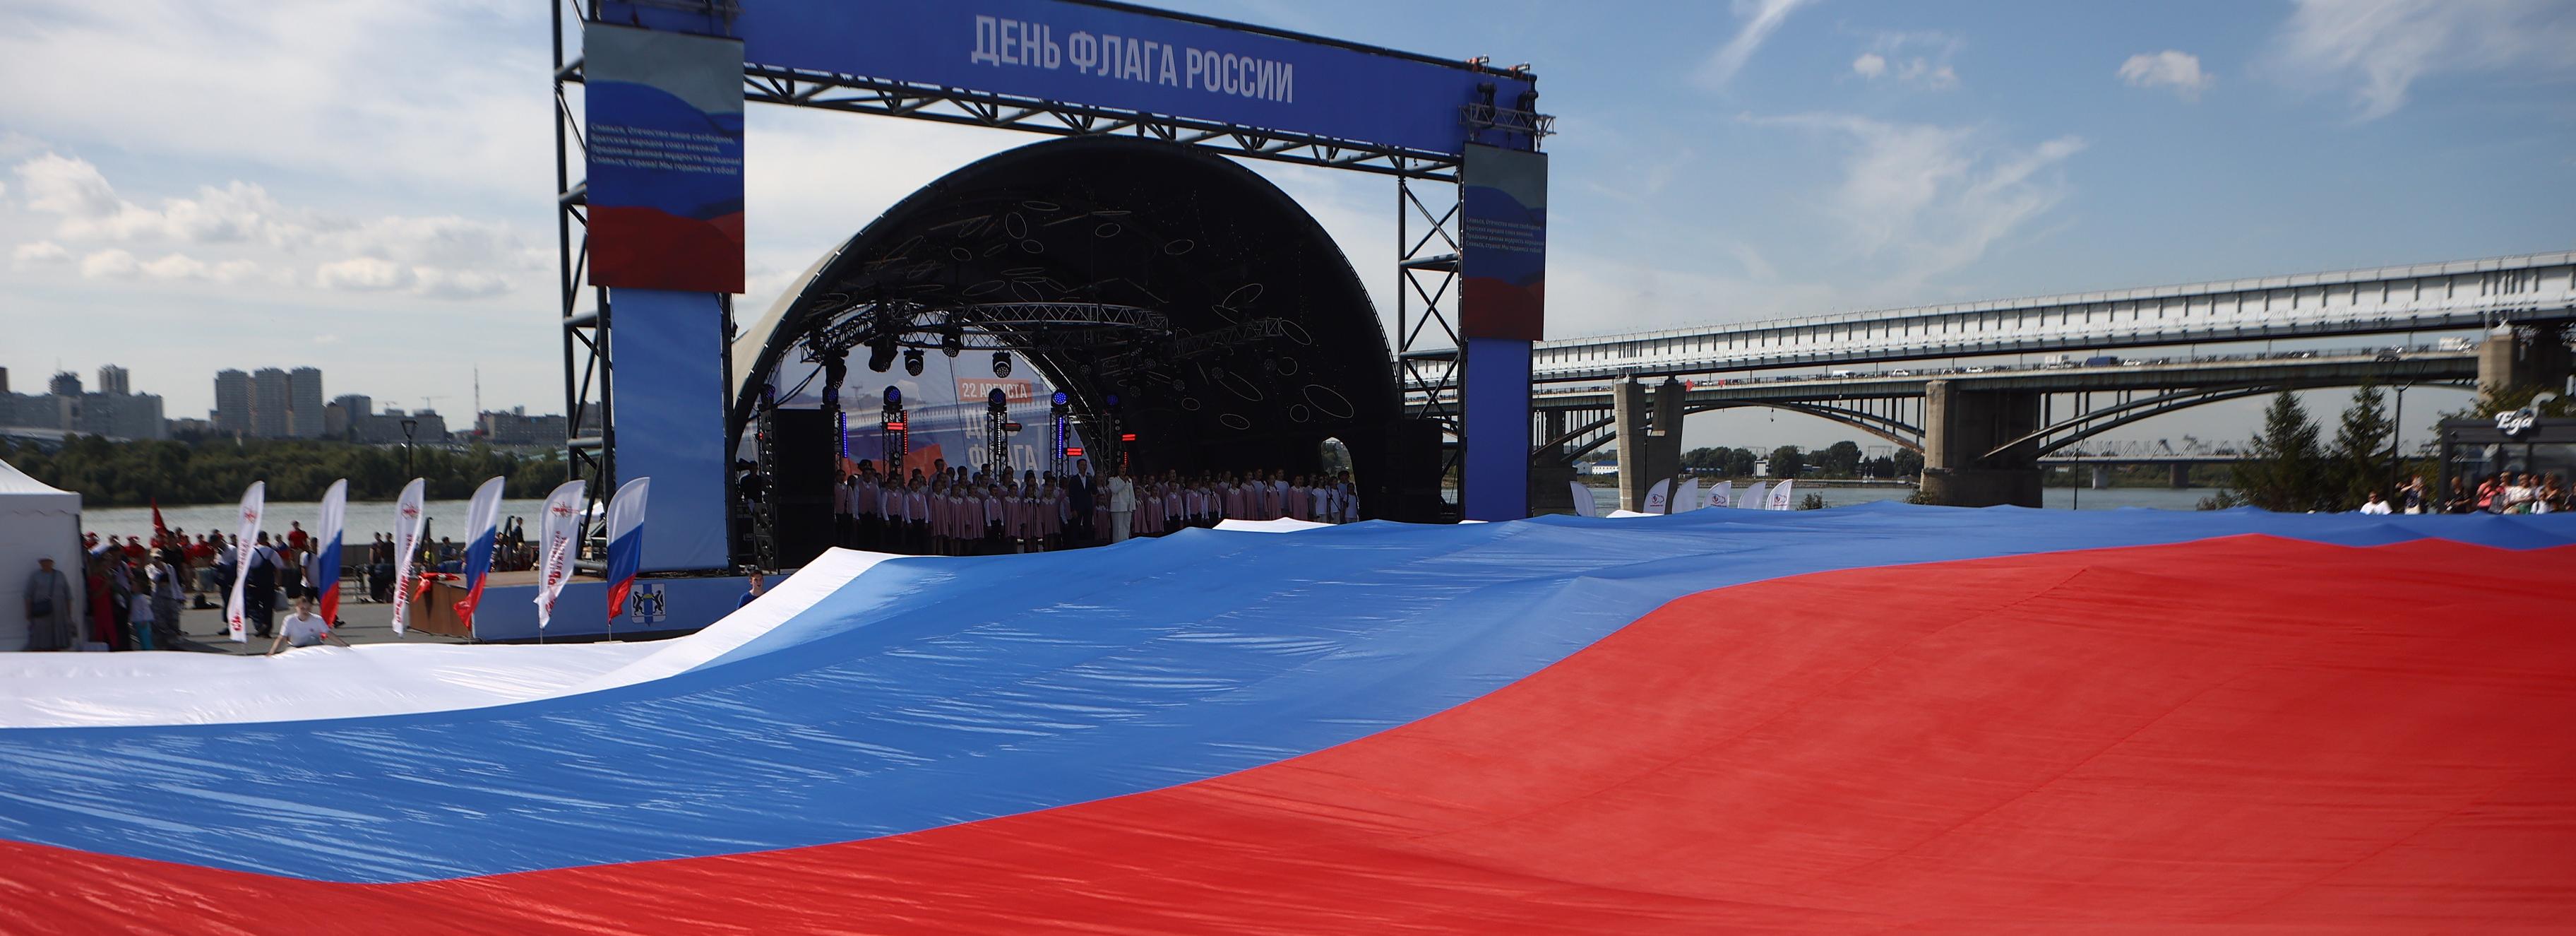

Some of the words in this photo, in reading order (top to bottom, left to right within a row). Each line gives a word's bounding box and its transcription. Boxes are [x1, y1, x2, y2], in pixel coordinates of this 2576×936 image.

[971, 15, 1061, 69] ДЕНЬ
[1068, 30, 1179, 88] ФЛАГА
[1186, 47, 1293, 103] РОССИИ
[962, 382, 977, 398] 22
[980, 383, 1028, 399] АВУСТА
[969, 444, 1039, 471] ФАГА
